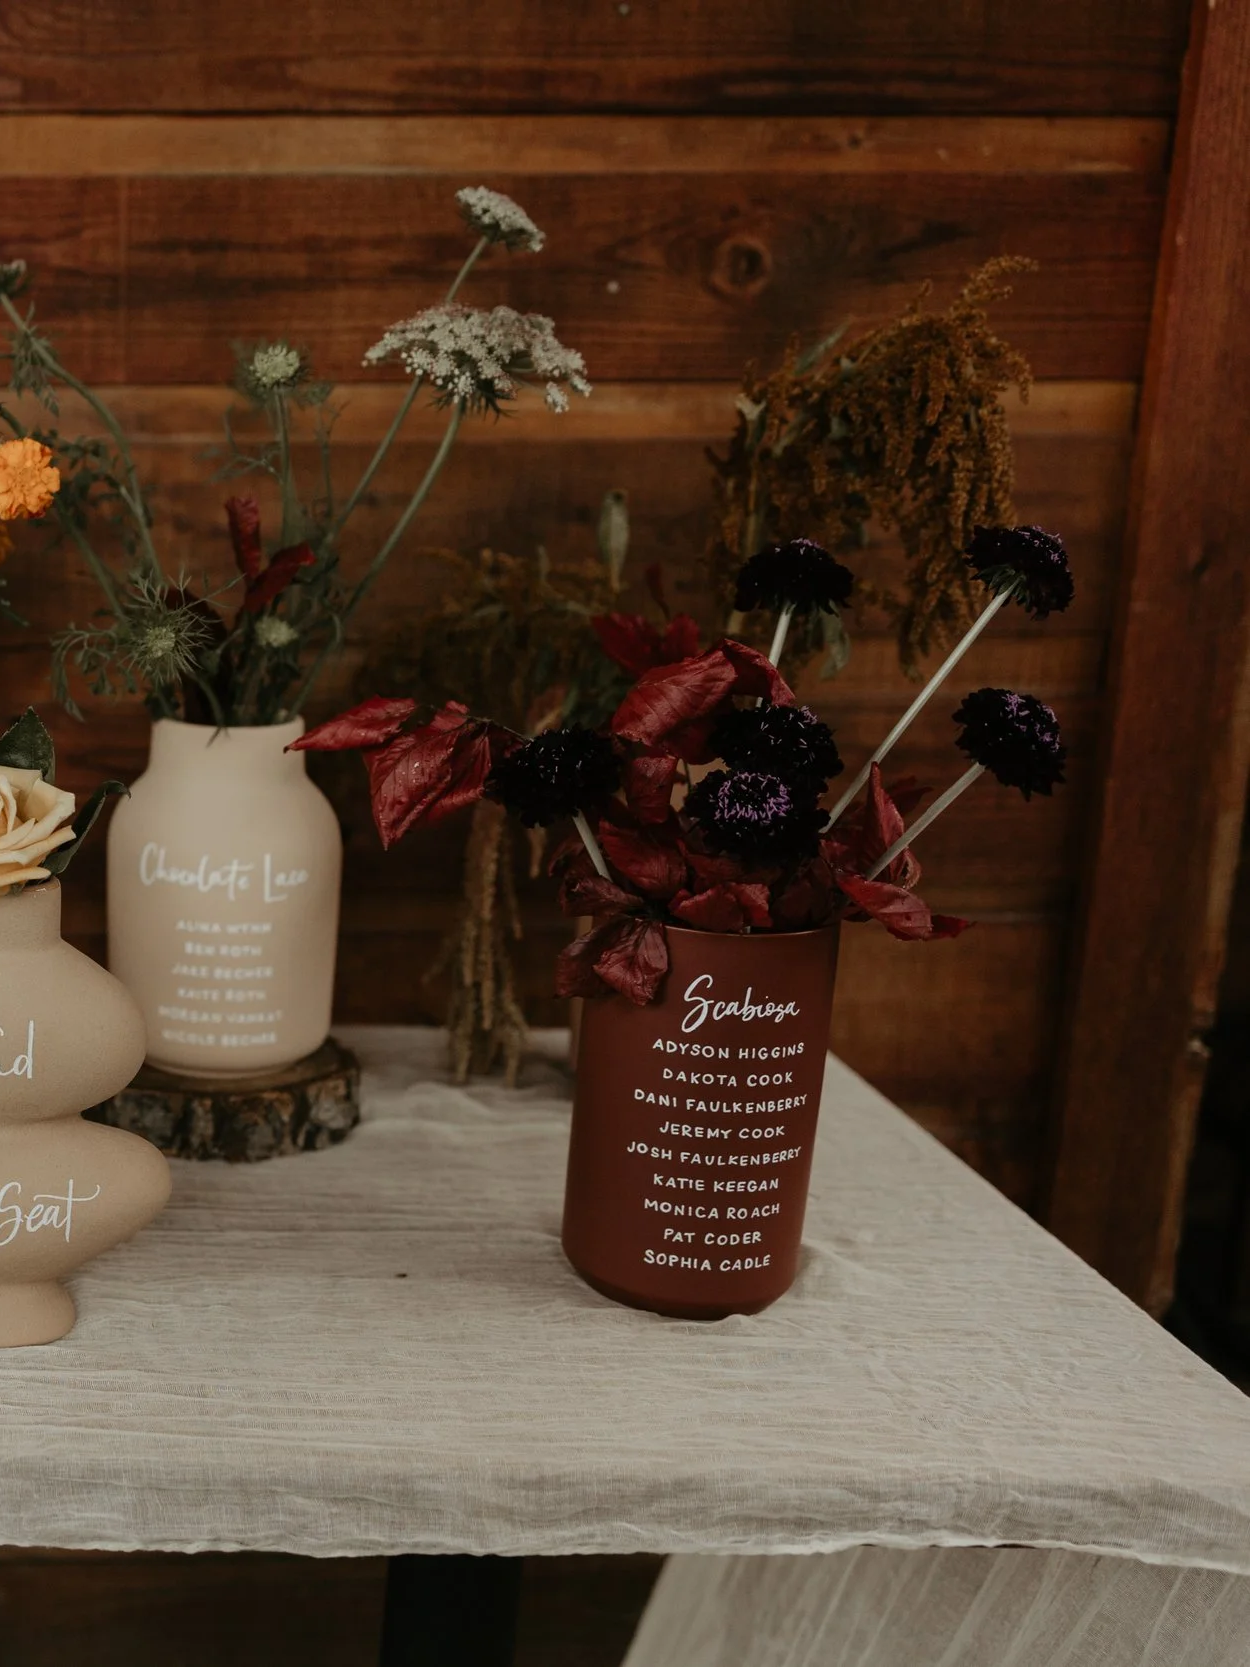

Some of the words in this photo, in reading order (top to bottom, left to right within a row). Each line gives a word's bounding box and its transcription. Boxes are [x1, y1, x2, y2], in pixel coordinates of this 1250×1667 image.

[139, 841, 254, 900] Chocolate
[264, 853, 309, 903] Lace
[681, 974, 800, 1033] Scabiosa
[652, 1038, 730, 1059] ADYSON
[738, 1042, 805, 1060] HIGGINS
[662, 1068, 738, 1087] DAKOTA
[746, 1071, 794, 1087] COOK
[634, 1088, 678, 1108] DANI
[686, 1094, 808, 1114] FAULKENBERRY
[659, 1121, 732, 1140] JEREMY
[738, 1125, 786, 1139] COOK
[626, 1141, 673, 1161] JOSH
[680, 1146, 802, 1167] FAULKENBERRY
[653, 1173, 706, 1191] KATIE
[713, 1178, 780, 1193] KEEGAN
[644, 1198, 720, 1220] MONICA
[726, 1203, 781, 1220] ROACH
[663, 1228, 697, 1244] PAT
[704, 1231, 763, 1246] CODER
[643, 1249, 713, 1272] SOPHIA
[719, 1254, 772, 1272] CADLE
